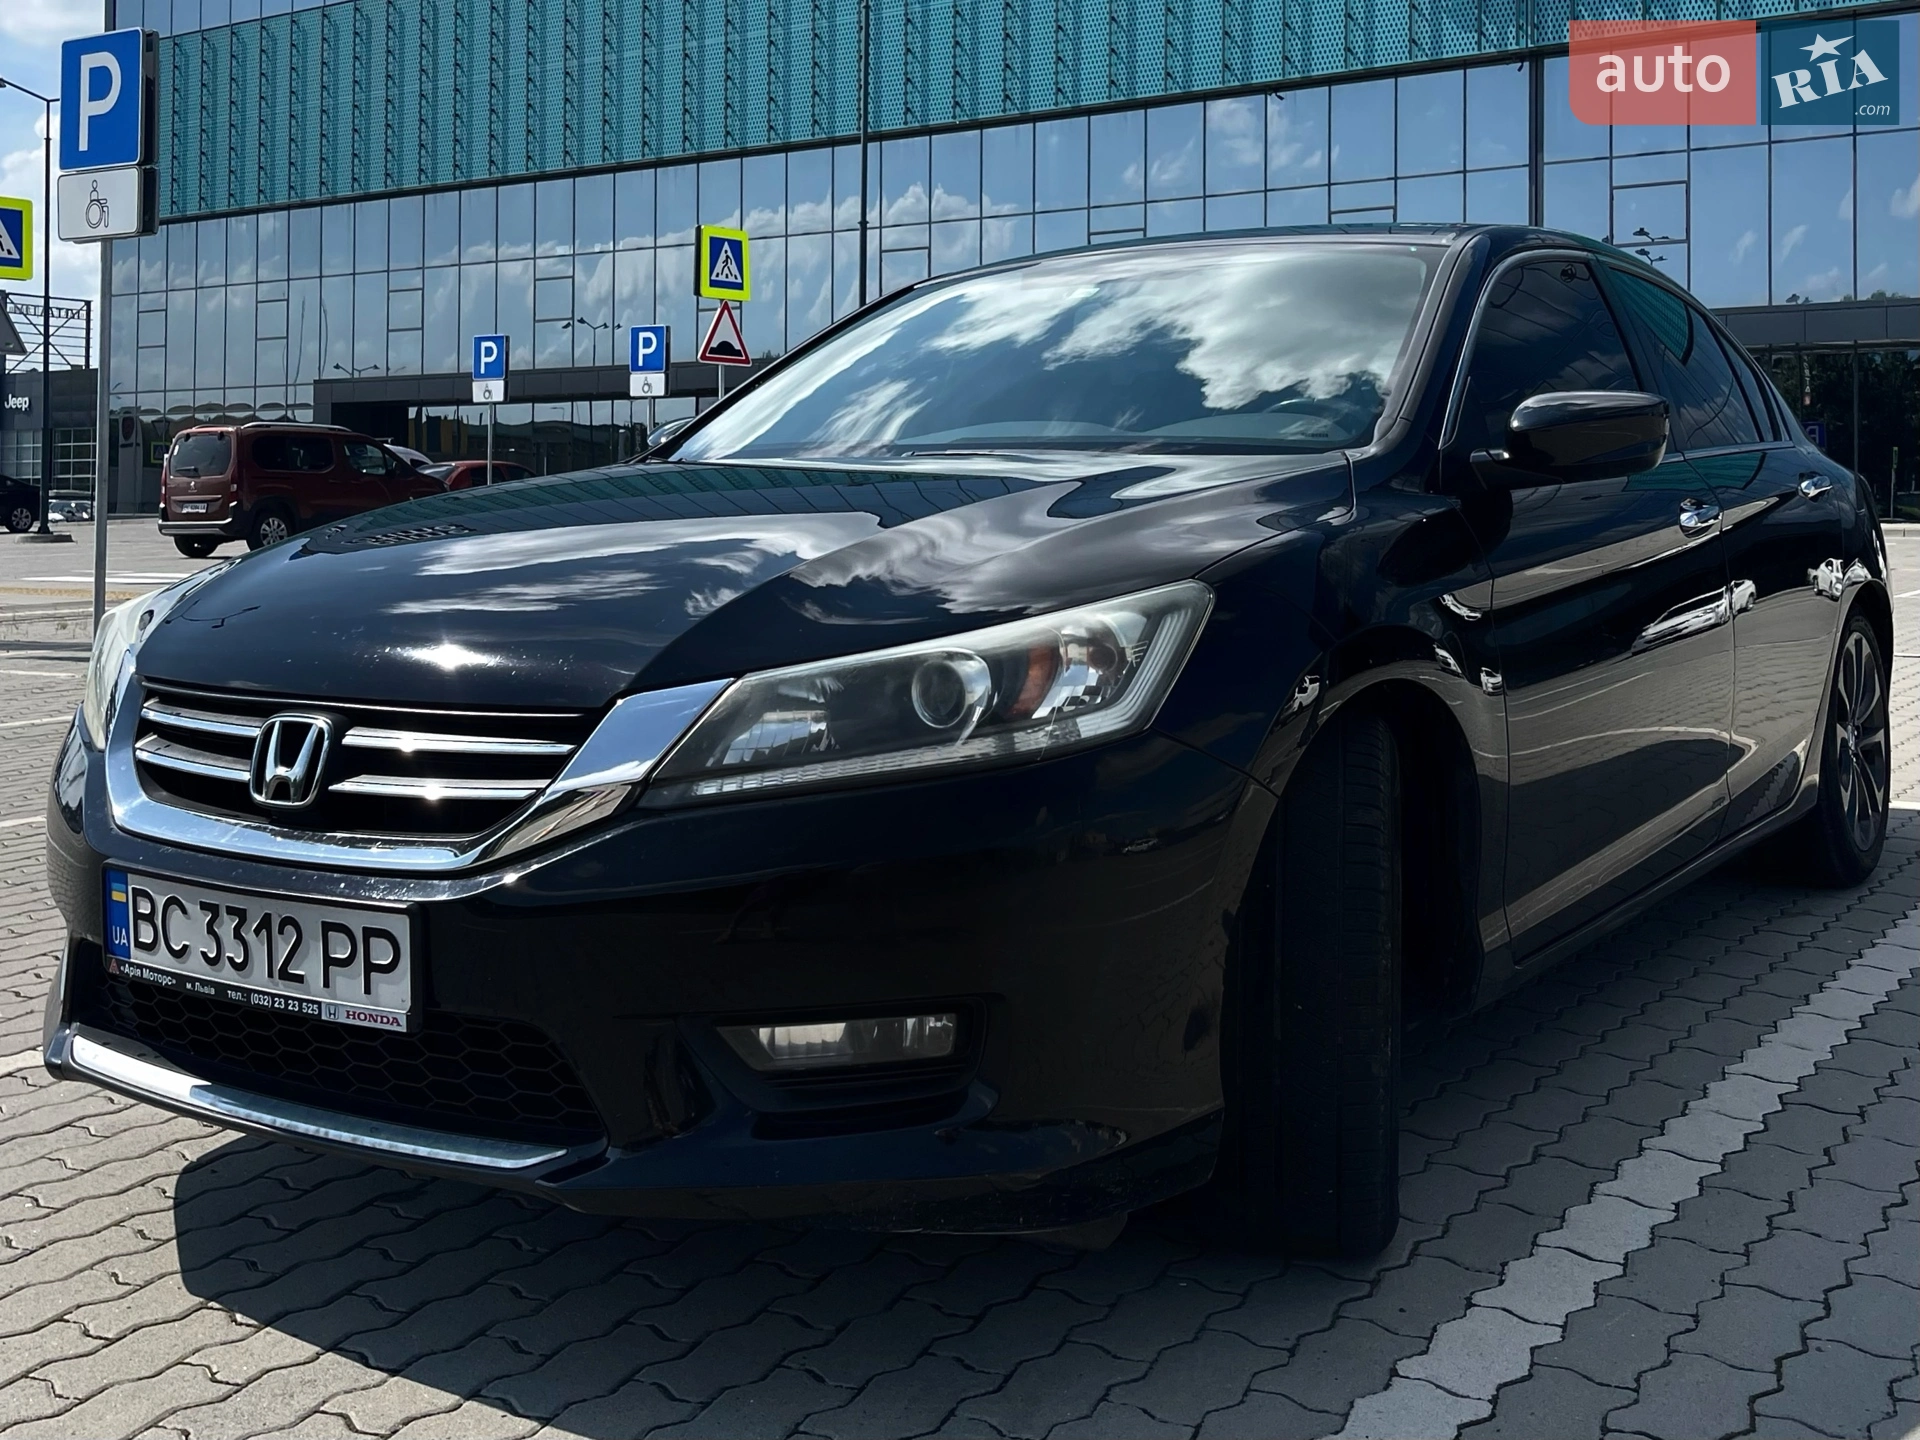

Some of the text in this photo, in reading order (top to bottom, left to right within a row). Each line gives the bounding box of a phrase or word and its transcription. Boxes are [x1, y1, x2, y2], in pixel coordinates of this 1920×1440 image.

[79, 51, 122, 152] P
[480, 341, 498, 374] P
[638, 331, 658, 367] P
[4, 393, 30, 412] Jeep
[112, 926, 128, 947] UA
[131, 886, 401, 996] BC 3312 PP
[250, 992, 272, 1008] (032)
[274, 997, 285, 1009] 23
[288, 1000, 299, 1012] 23
[302, 1002, 319, 1015] 525
[345, 1009, 402, 1027] HONDA
